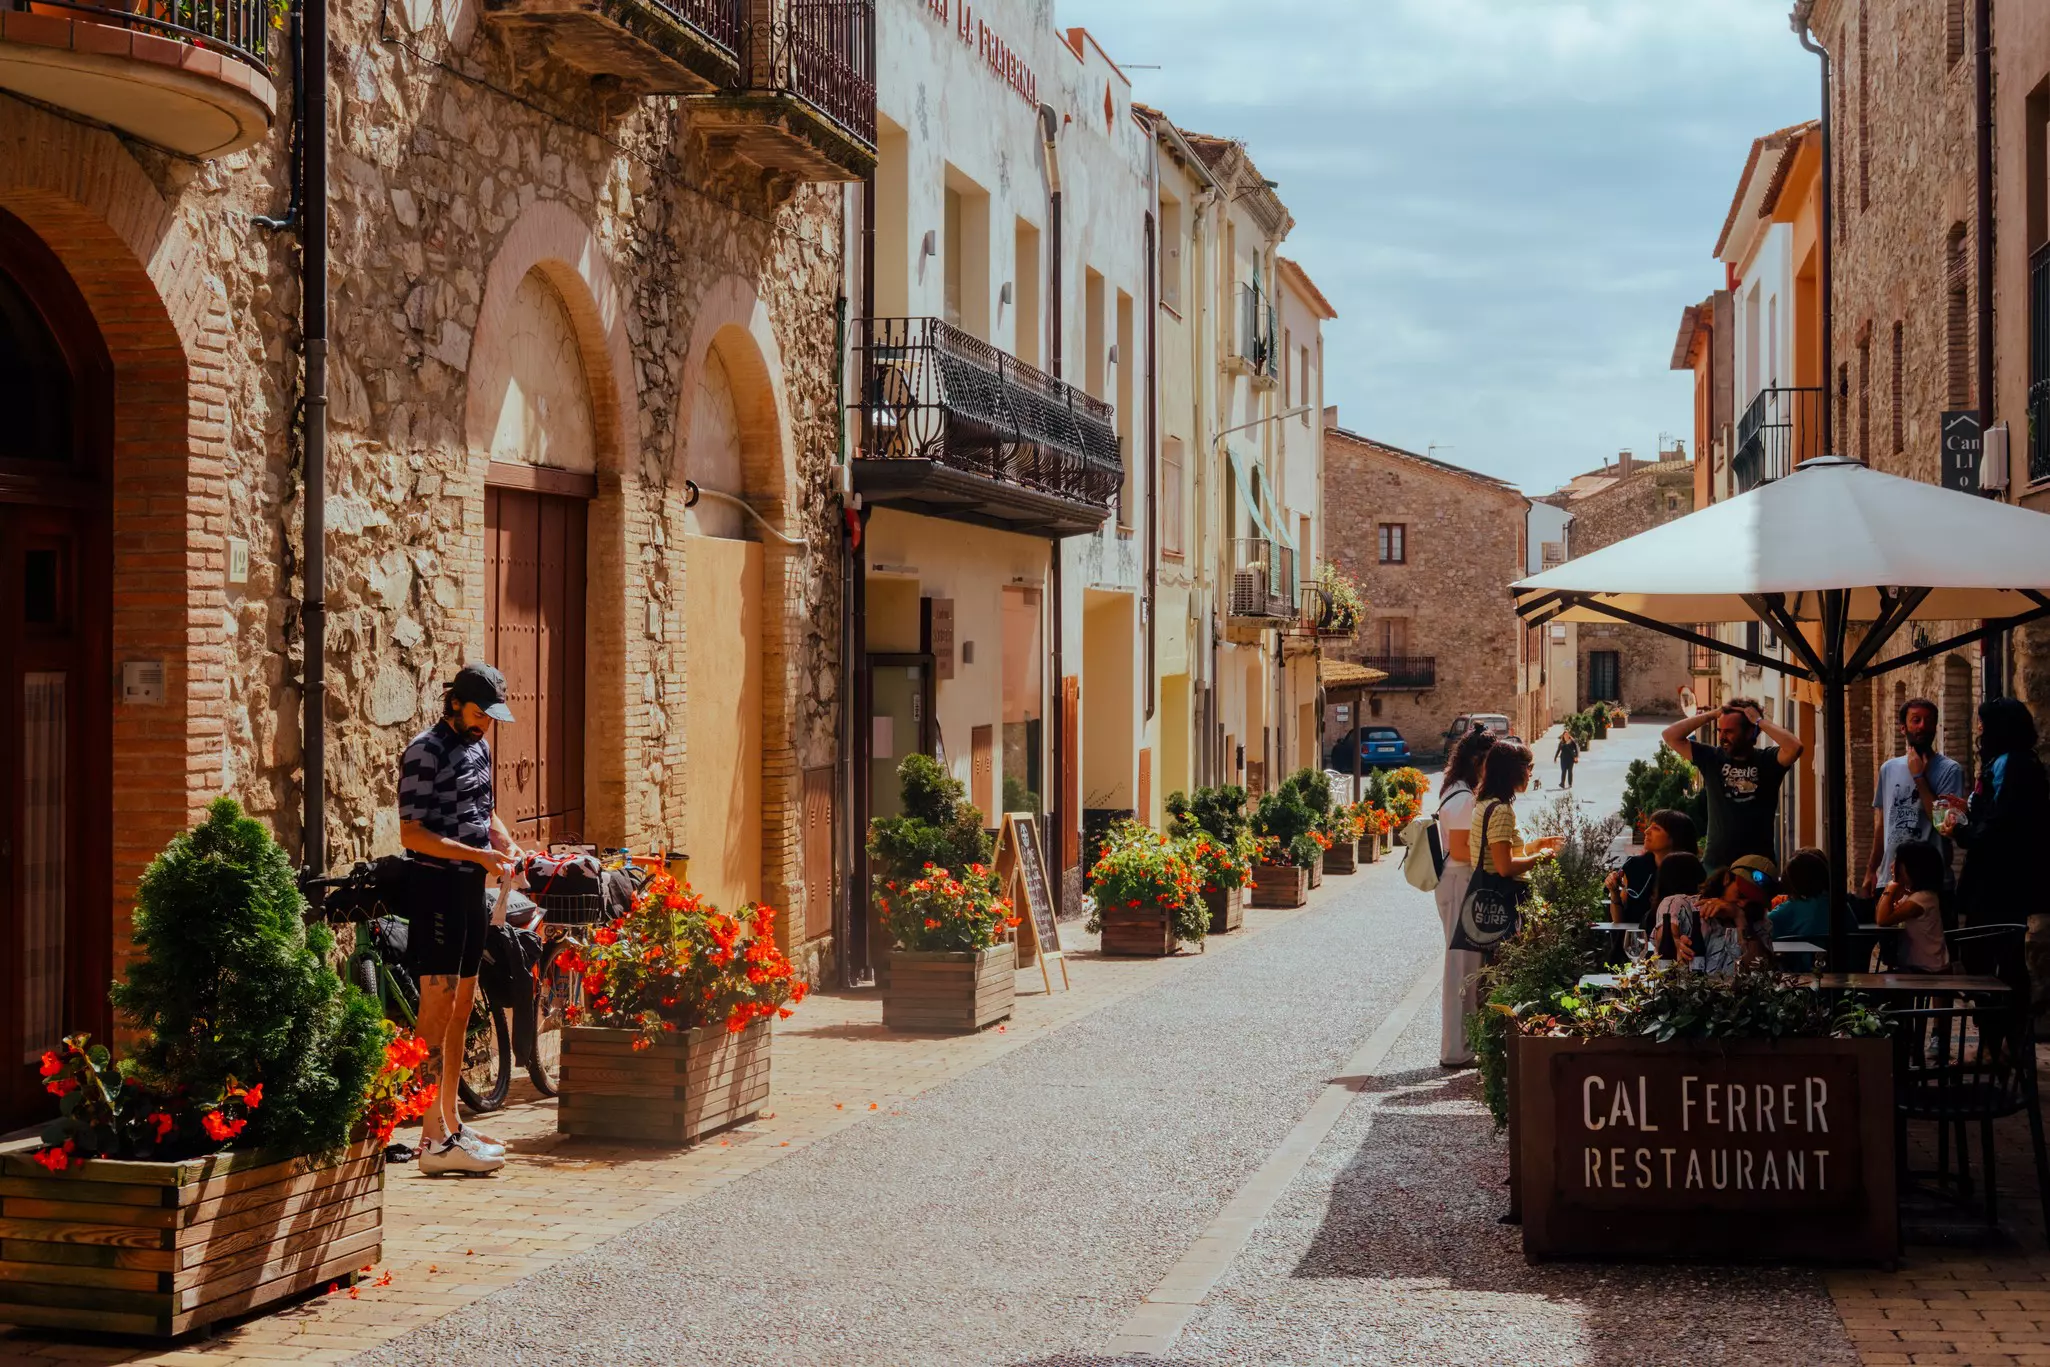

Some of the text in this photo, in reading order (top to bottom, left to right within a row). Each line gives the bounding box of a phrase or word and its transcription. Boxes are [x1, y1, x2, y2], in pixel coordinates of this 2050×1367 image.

[957, 0, 1040, 108] LA FRATERNAL
[232, 549, 246, 574] 12
[1474, 901, 1506, 915] NADA
[1475, 912, 1509, 925] SURF
[1583, 1075, 1830, 1133] CAL FERRER
[1584, 1147, 1830, 1190] RESTAURANT
